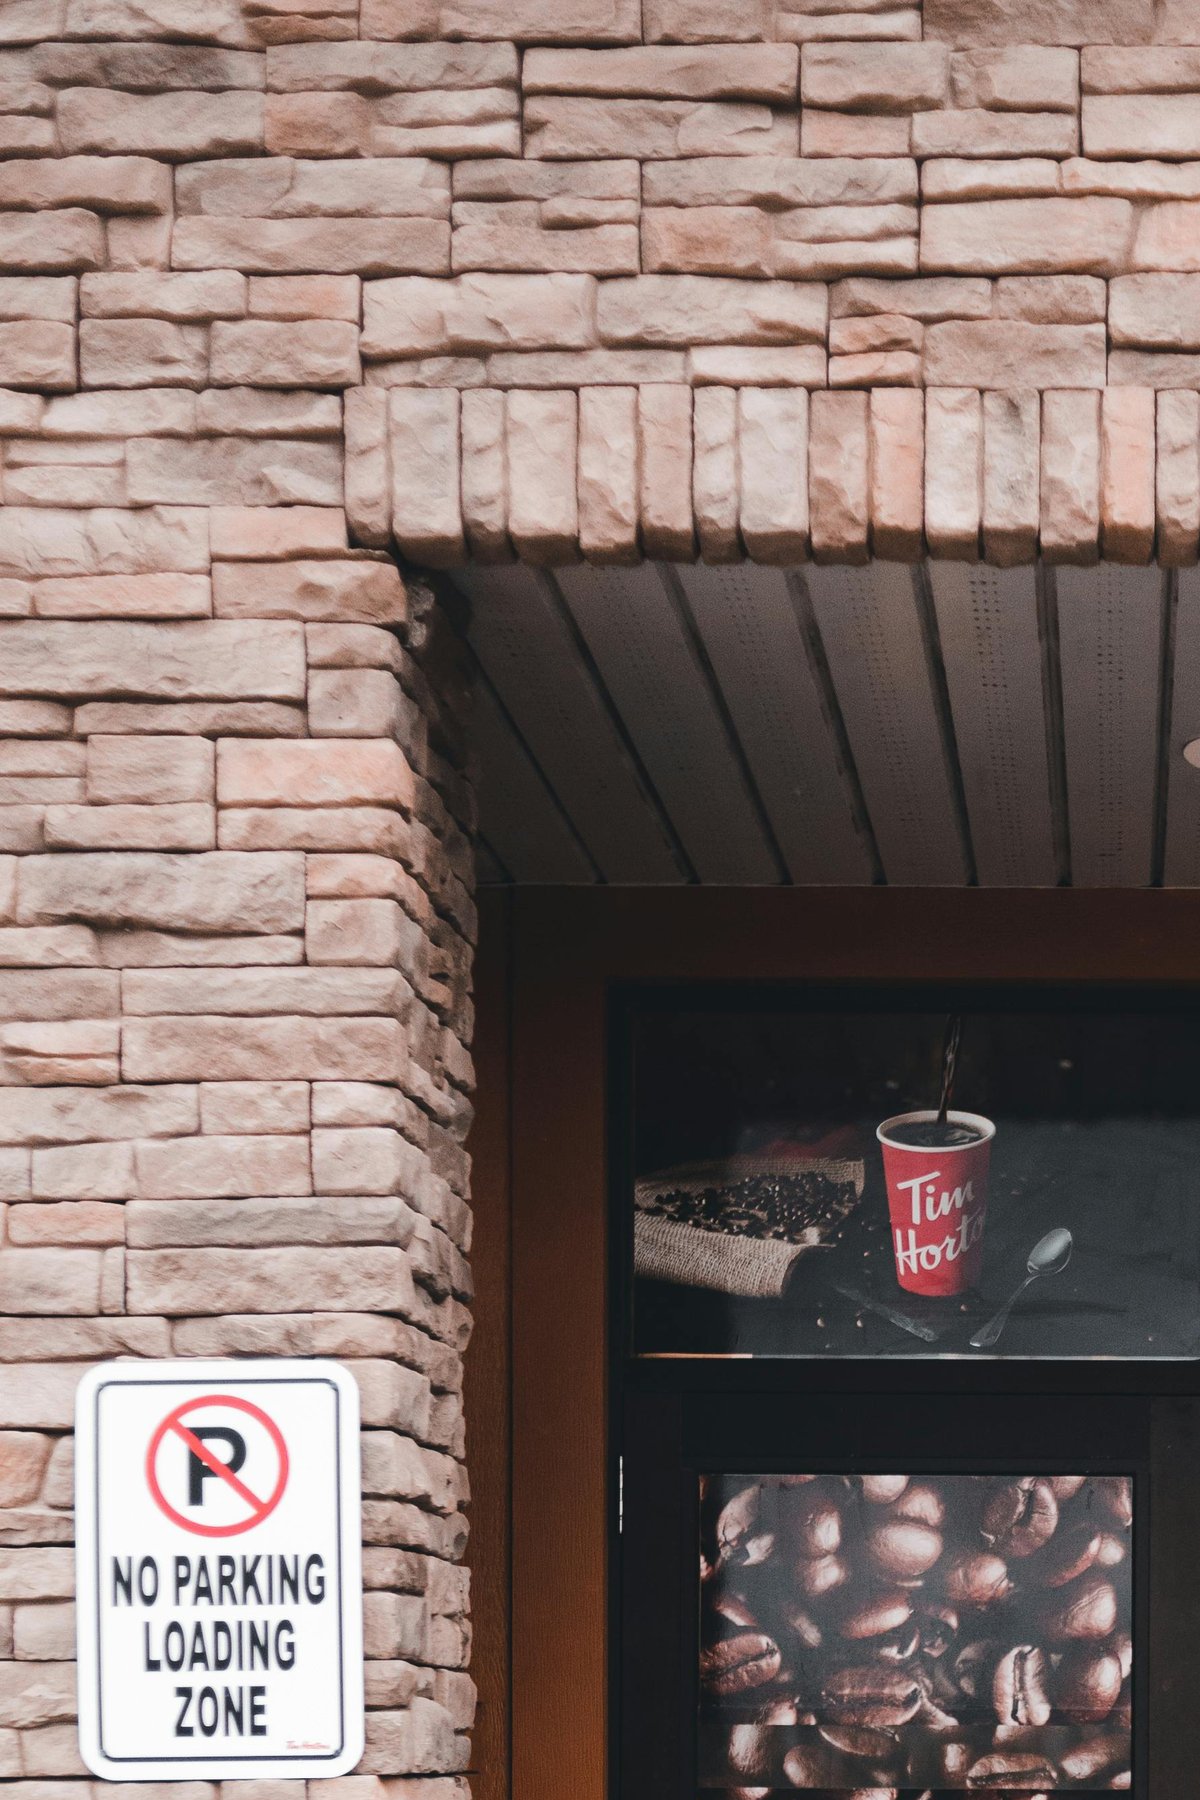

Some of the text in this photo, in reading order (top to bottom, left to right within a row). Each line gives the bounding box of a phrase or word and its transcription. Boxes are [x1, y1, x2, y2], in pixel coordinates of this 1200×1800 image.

[896, 1171, 975, 1225] Tim
[112, 1553, 326, 1607] NO PARKING
[144, 1619, 296, 1672] LOADING
[174, 1686, 268, 1737] ZONE
